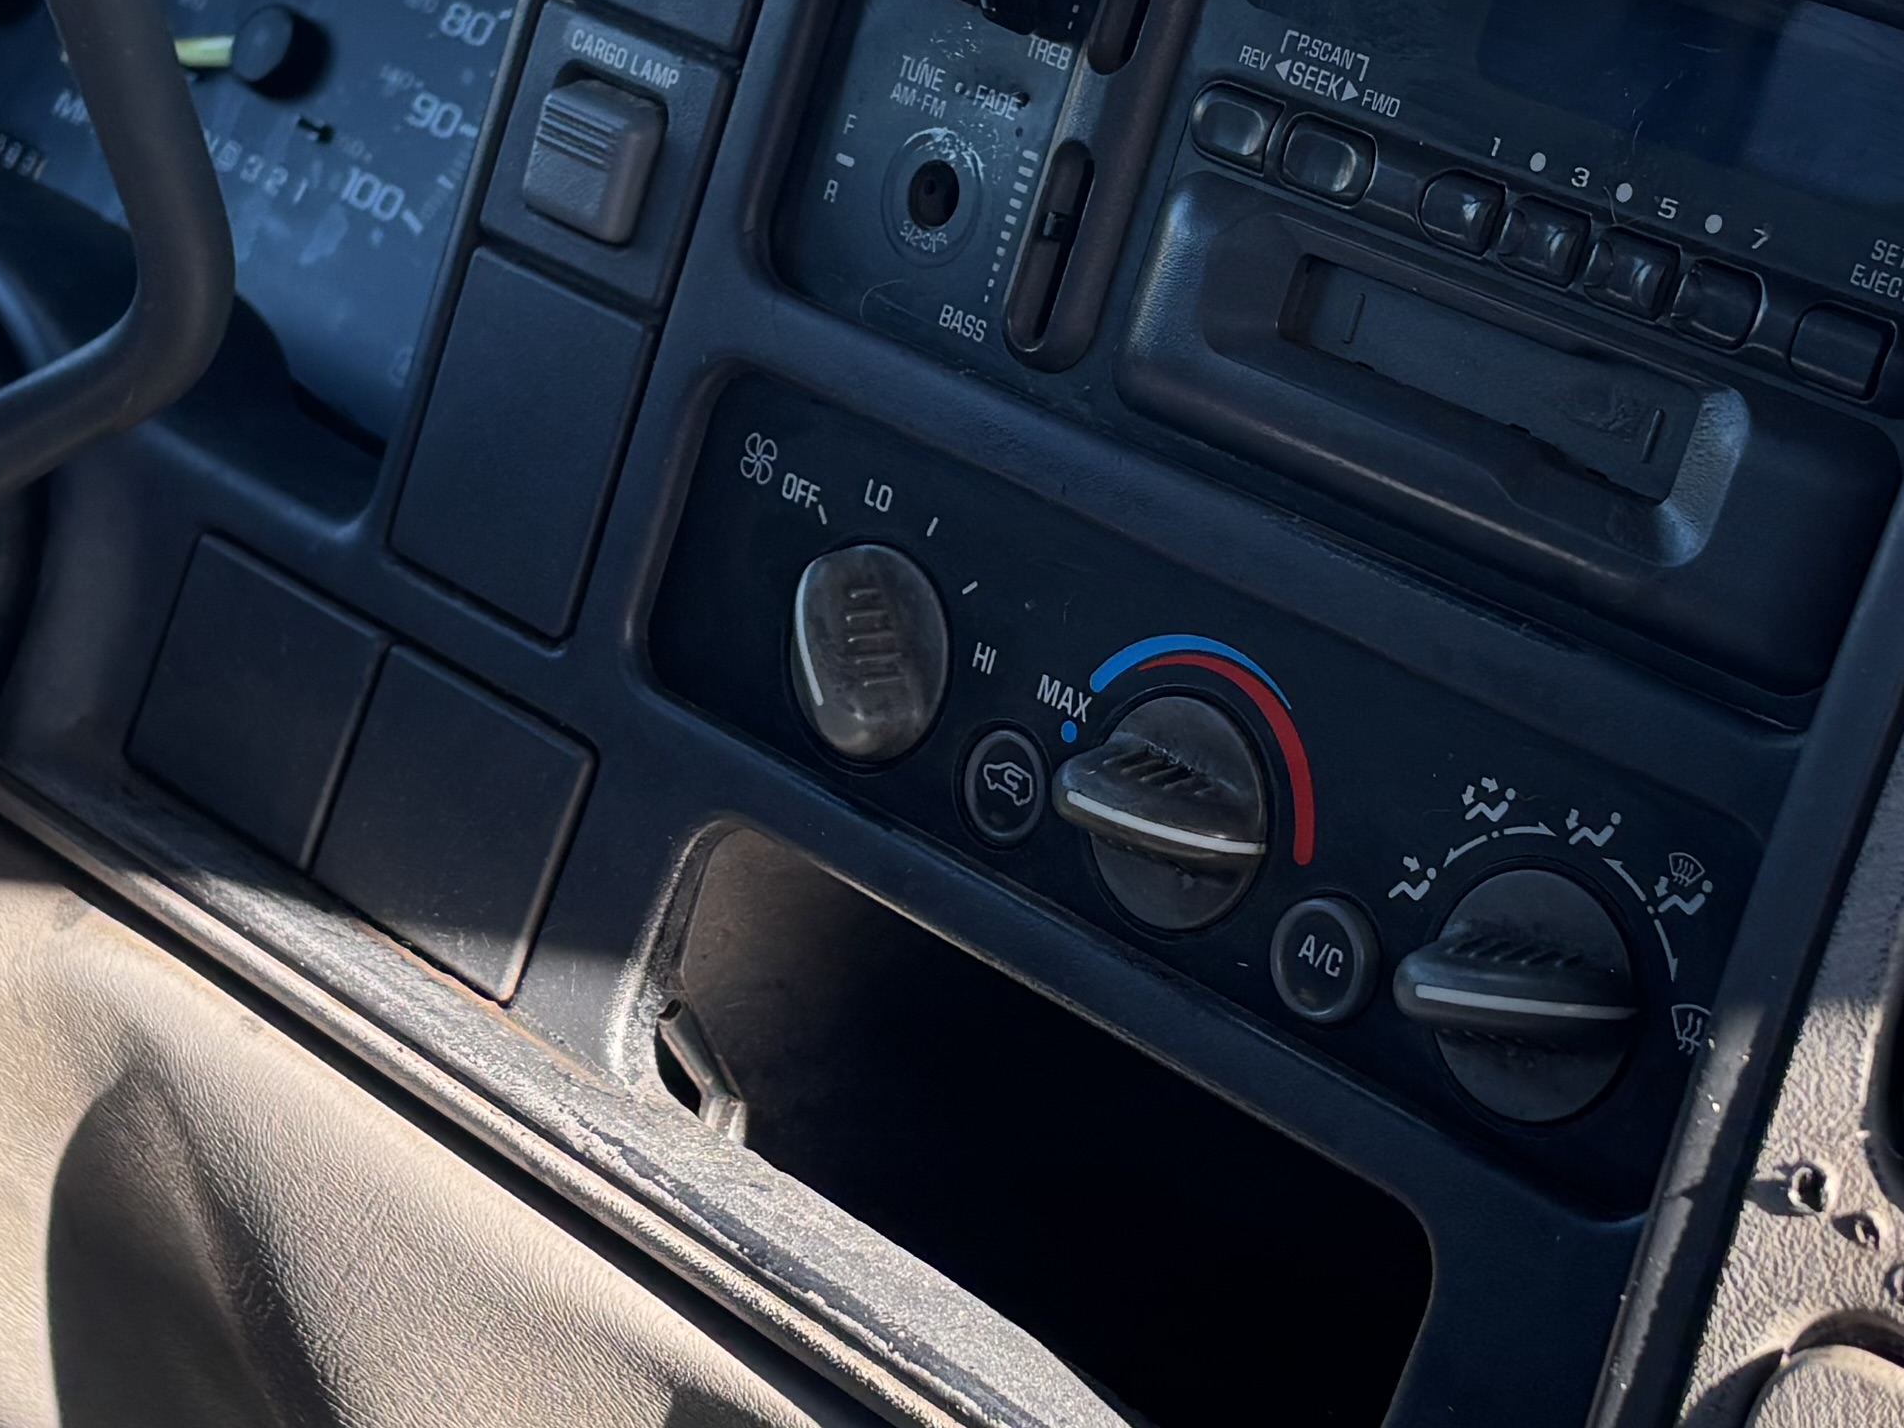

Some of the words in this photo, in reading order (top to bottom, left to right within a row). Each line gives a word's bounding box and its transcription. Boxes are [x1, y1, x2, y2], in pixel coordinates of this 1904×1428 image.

[437, 0, 496, 47] 80
[570, 28, 628, 70] CARGO
[629, 53, 680, 89] LAMP
[1025, 33, 1073, 71] TREB
[1297, 34, 1356, 70] P.SCAN
[899, 55, 946, 92] TUNE
[972, 84, 1021, 121] FADE
[1238, 45, 1272, 71] REV
[1289, 62, 1344, 100] SEEK
[1361, 89, 1401, 118] FWD
[404, 90, 464, 140] 90
[843, 113, 858, 135] F
[341, 164, 406, 223] 100
[823, 178, 840, 204] R
[1491, 137, 1501, 158] 1
[1570, 165, 1591, 189] 3
[1657, 197, 1680, 221] 5
[1751, 226, 1771, 249] 7
[938, 303, 988, 343] BASS
[782, 473, 821, 509] OFF
[864, 478, 893, 512] LO
[972, 641, 997, 675] HI
[1037, 674, 1093, 723] MAX
[1298, 934, 1344, 978] A/C
